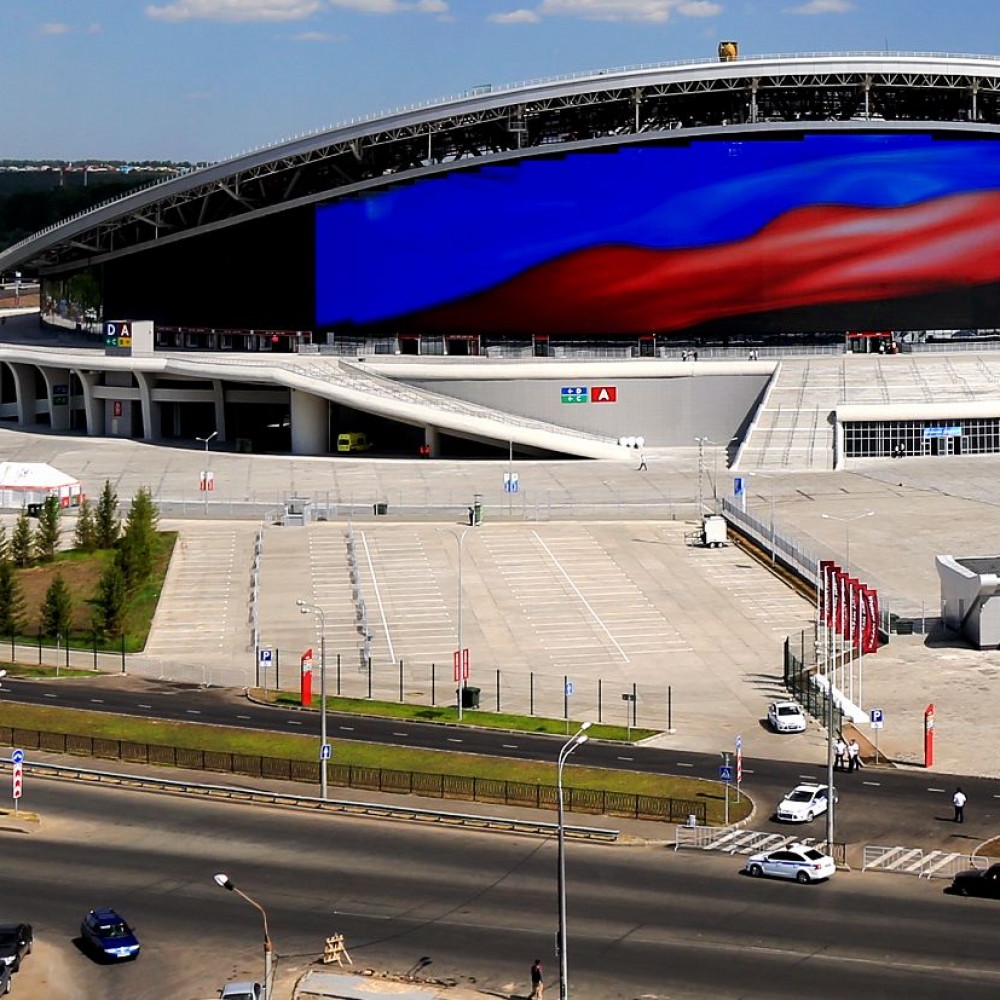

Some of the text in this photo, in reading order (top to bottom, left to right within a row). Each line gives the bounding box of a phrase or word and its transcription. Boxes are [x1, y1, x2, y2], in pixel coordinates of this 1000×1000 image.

[107, 324, 129, 336] D A
[598, 388, 609, 400] A
[263, 651, 270, 661] P
[873, 711, 880, 721] P
